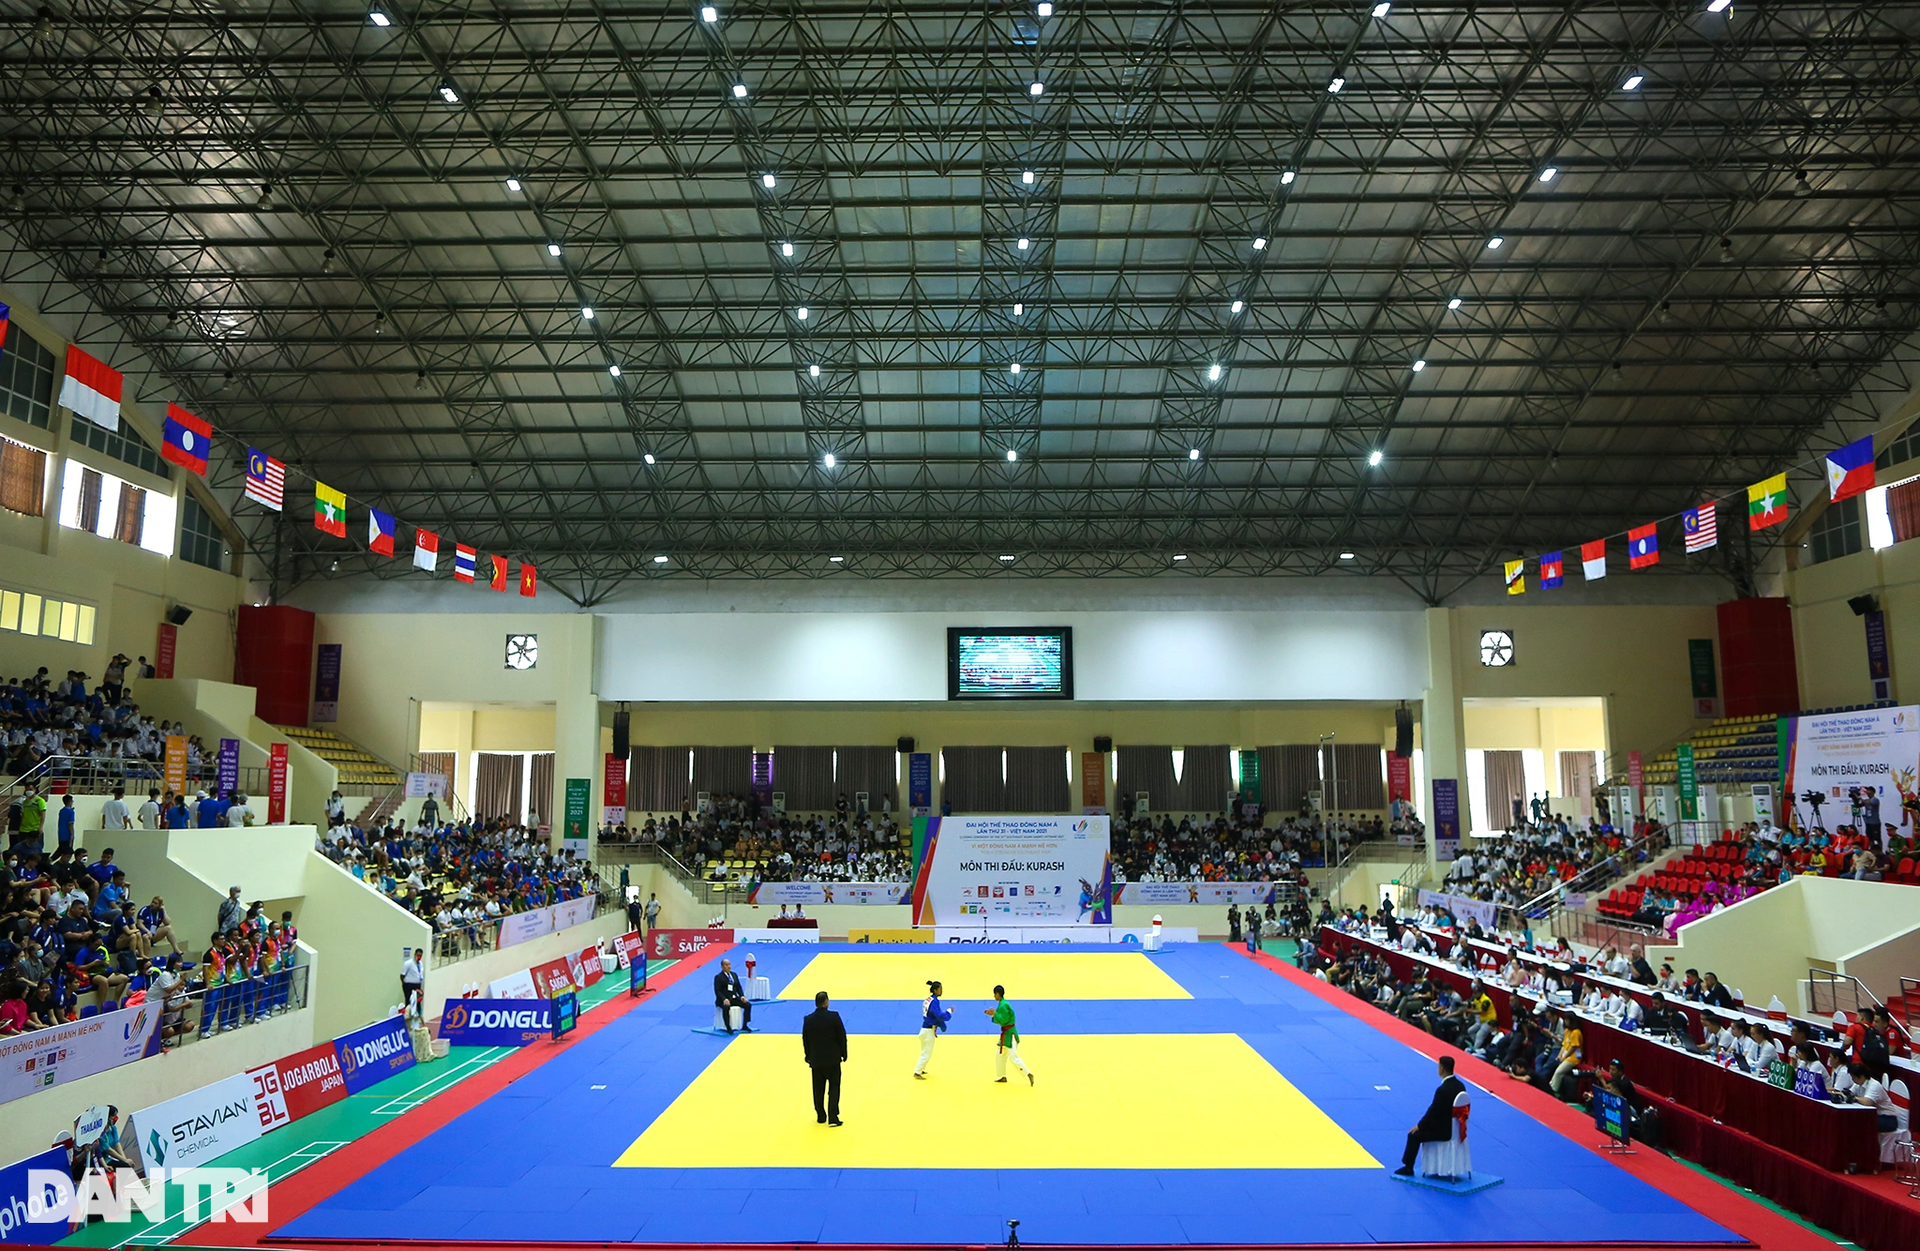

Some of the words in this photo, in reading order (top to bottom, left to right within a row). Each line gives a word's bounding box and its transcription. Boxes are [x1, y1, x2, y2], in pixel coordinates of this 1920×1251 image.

[1811, 763, 1828, 776] MÔN
[1828, 766, 1840, 776] THI
[1840, 761, 1858, 776] ĐẤU:
[1860, 763, 1890, 775] KURASH
[990, 820, 1001, 828] THỂ
[960, 859, 982, 871] MÔN
[984, 862, 999, 871] THI
[1001, 858, 1024, 872] ĐẤU:
[1026, 862, 1065, 871] KURASH
[678, 942, 712, 952] SAIG
[13, 1040, 34, 1053] ĐÔNG
[34, 1036, 50, 1047] NAM
[51, 1034, 57, 1043] Á
[58, 1031, 76, 1042] MẠNH
[78, 1026, 87, 1036] MẼ
[522, 1032, 548, 1040] SPO
[354, 1028, 409, 1067] DONGLUC
[283, 1054, 340, 1092] JOGARBOLA
[1770, 1061, 1785, 1074] 001
[1797, 1070, 1814, 1083] 000
[254, 1071, 278, 1100] JG
[321, 1073, 344, 1093] JAPAN
[172, 1098, 248, 1143] STAVIAN
[257, 1100, 286, 1126] BL
[80, 1118, 102, 1136] THAILAND
[176, 1135, 219, 1159] CHEMICAL
